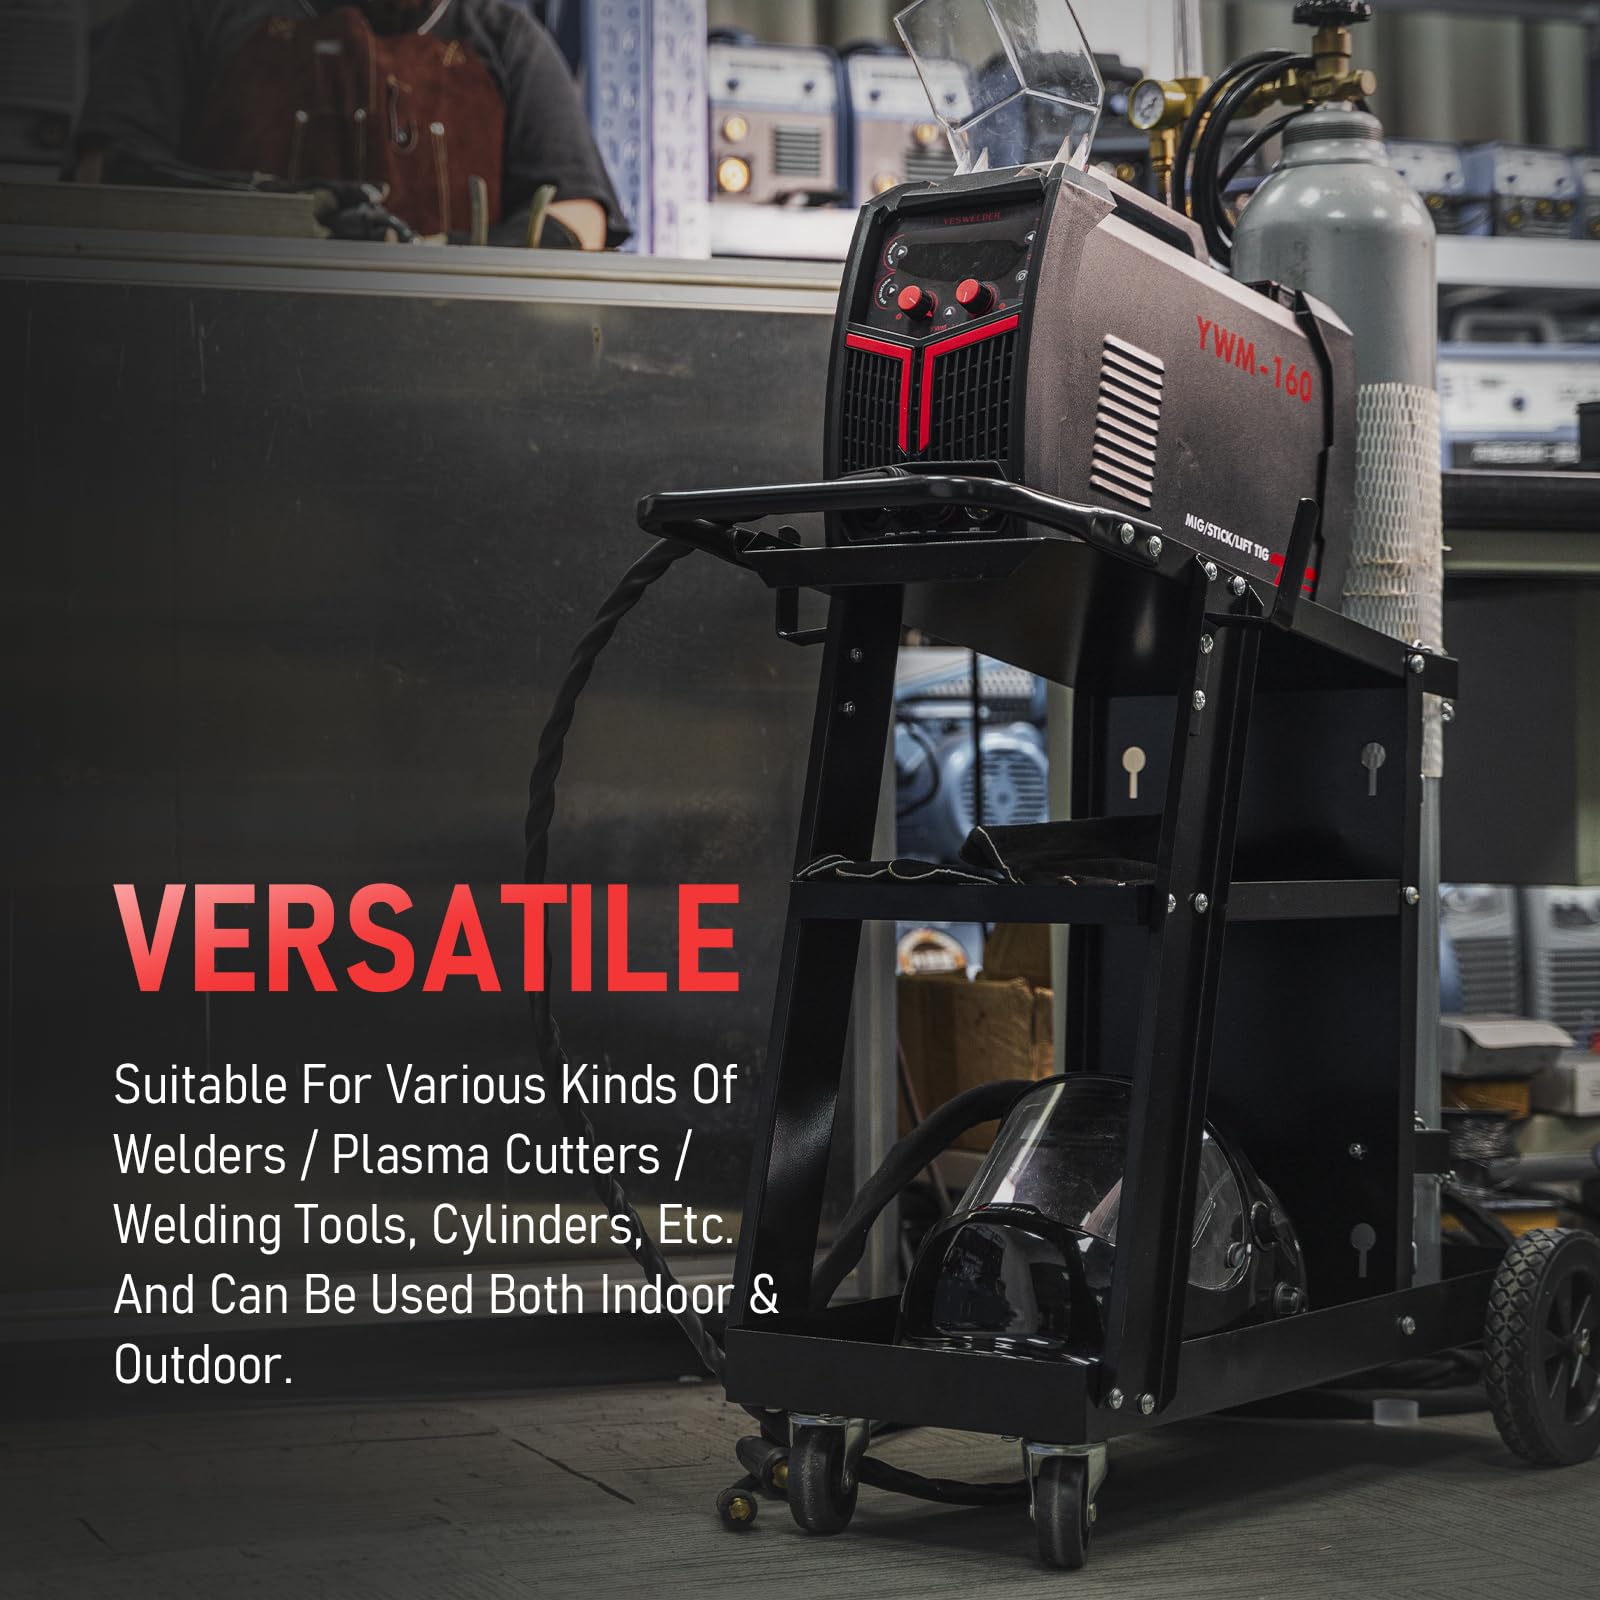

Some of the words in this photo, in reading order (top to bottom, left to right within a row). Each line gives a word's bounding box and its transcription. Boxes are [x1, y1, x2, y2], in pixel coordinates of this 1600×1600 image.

[1195, 314, 1313, 404] YWM-160
[1184, 512, 1254, 554] MIG/STICK/LIFT
[1253, 543, 1270, 562] TIG
